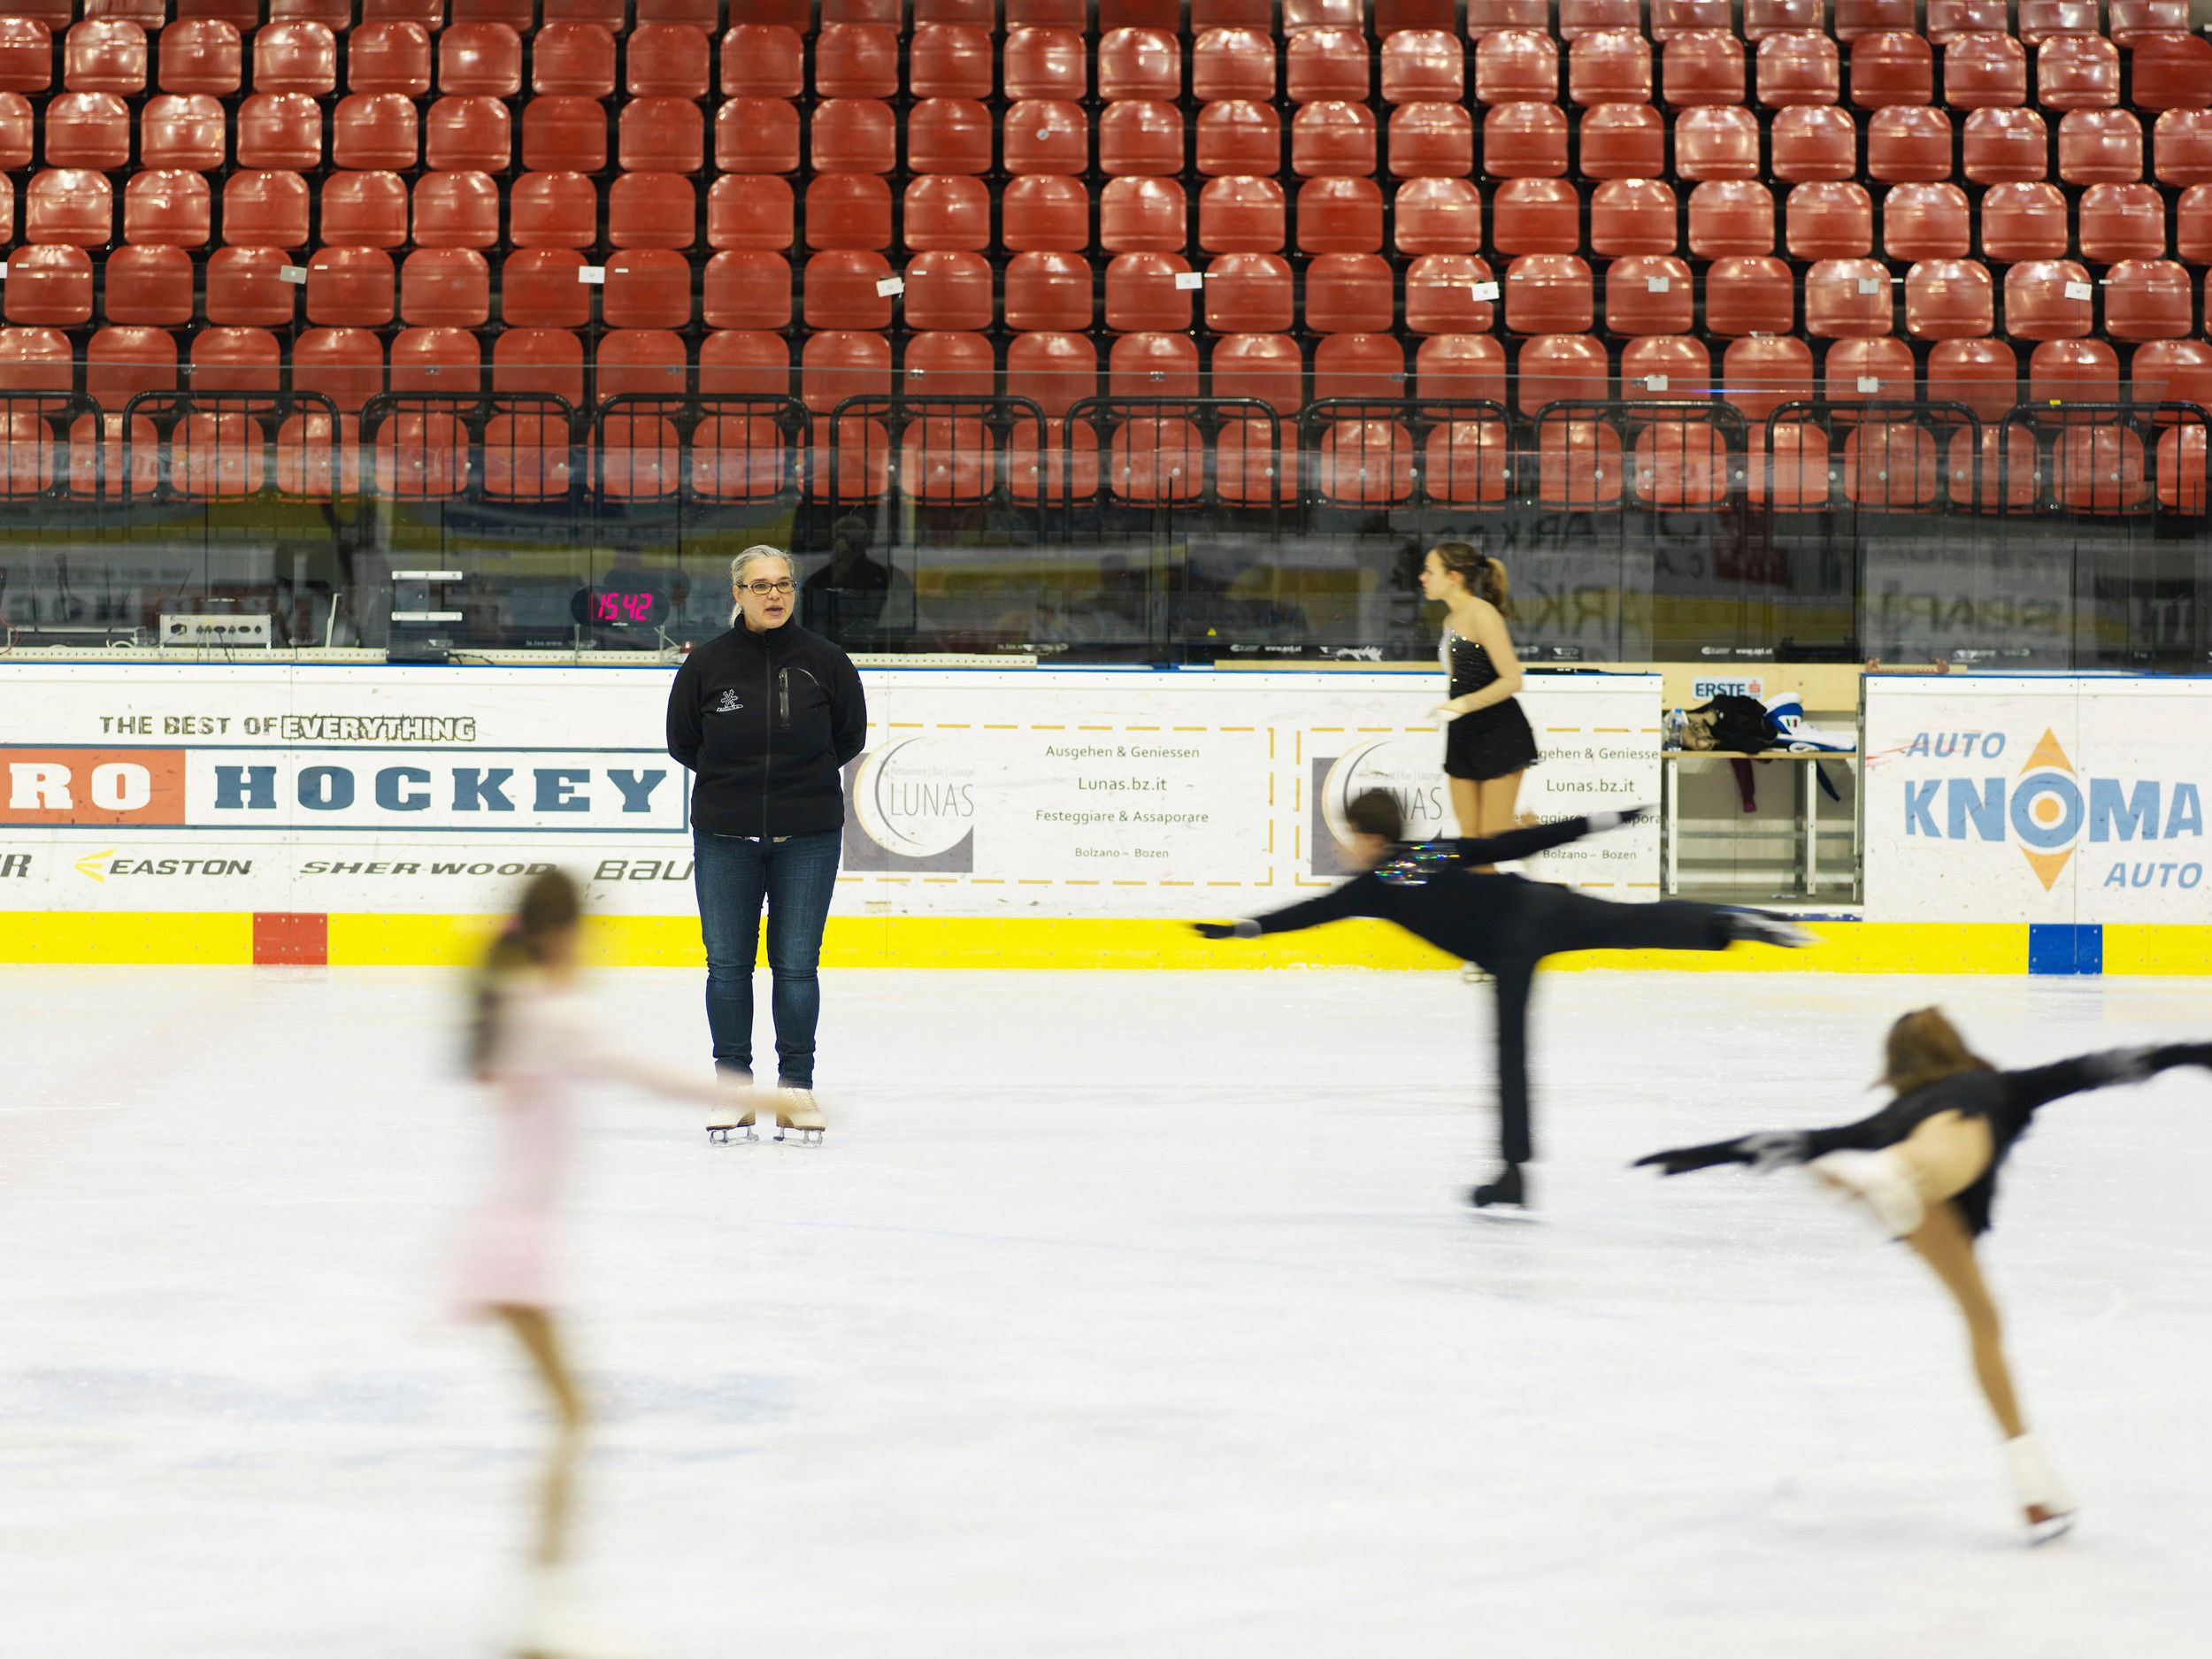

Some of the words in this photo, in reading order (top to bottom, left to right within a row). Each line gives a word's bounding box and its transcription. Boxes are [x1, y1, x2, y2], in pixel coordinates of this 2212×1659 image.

[1695, 683, 1745, 697] ERSTE
[99, 716, 153, 734] THE
[164, 716, 231, 735] BEST
[243, 717, 278, 735] OF
[280, 713, 477, 741] EVERYTHING
[1045, 745, 1113, 760] Ausgehen
[1117, 746, 1126, 757] &
[1131, 746, 1200, 758] Geniessen
[1906, 732, 2006, 758] AUTO
[1537, 747, 1580, 761] gehen
[1584, 748, 1594, 759] &
[214, 764, 667, 812] HOCKEY
[1078, 777, 1167, 790] Lunas.bz.it
[1546, 778, 1635, 792] Lunas.bz.it
[890, 783, 974, 817] LUNAS
[1035, 810, 1115, 825] Festeggiare
[1118, 810, 1128, 822] &
[1133, 810, 1210, 826] Assaporare
[1905, 772, 2203, 848] KNOMA
[1074, 847, 1120, 858] Bolzano
[1134, 848, 1170, 858] Bozen
[1542, 849, 1588, 860] Bolzano
[1601, 849, 1637, 860] Bozen
[109, 859, 253, 876] EASTON
[2103, 862, 2203, 888] AUTO
